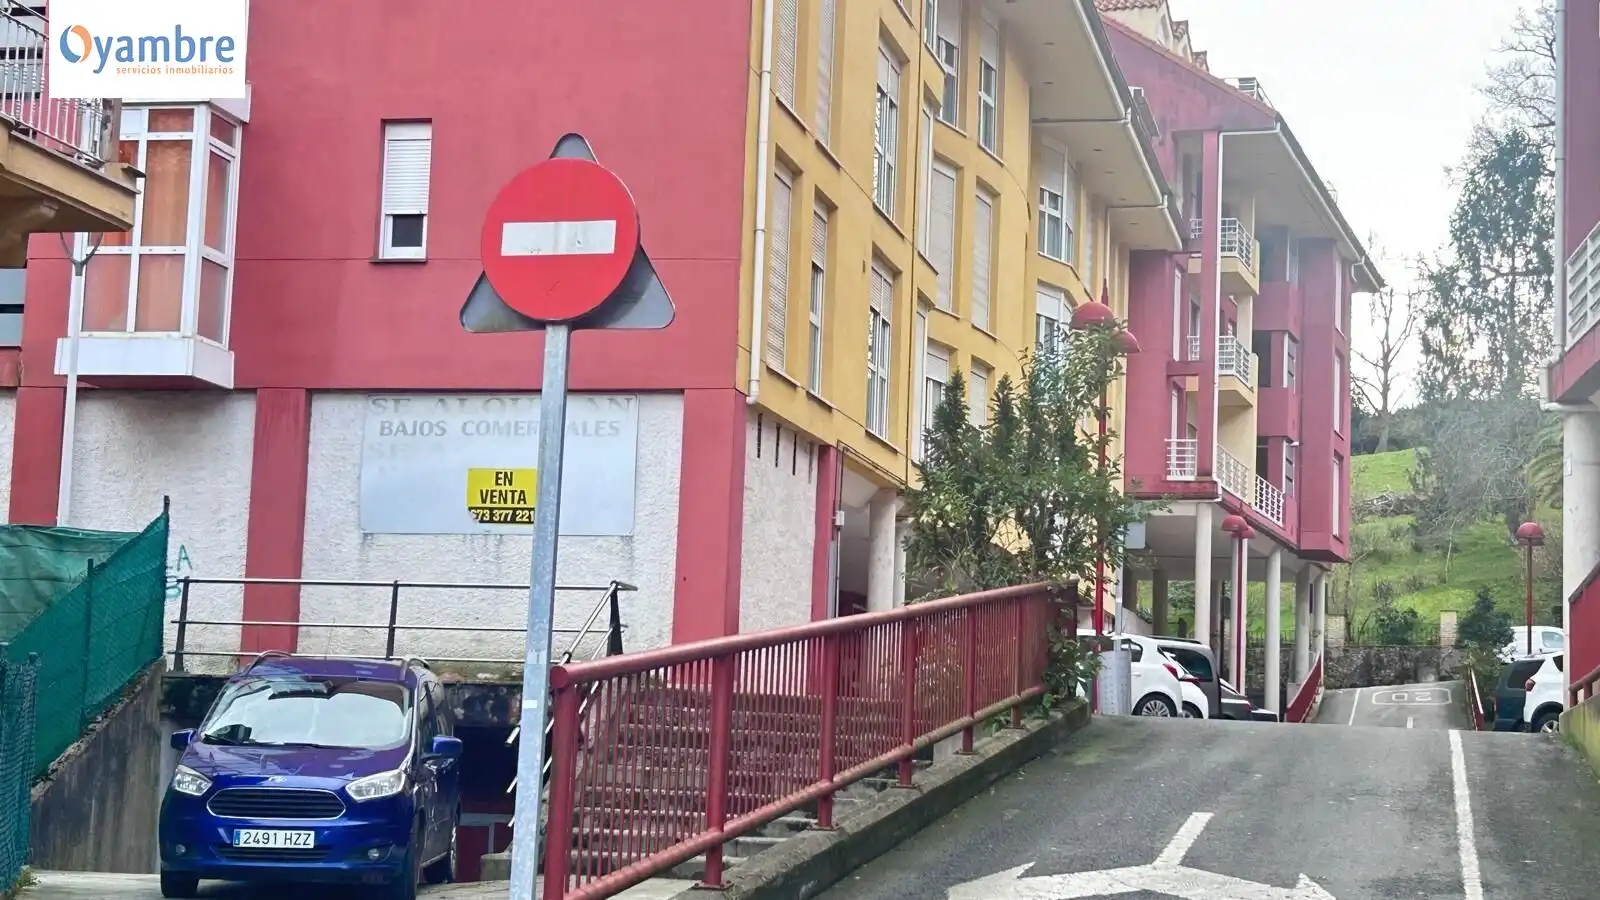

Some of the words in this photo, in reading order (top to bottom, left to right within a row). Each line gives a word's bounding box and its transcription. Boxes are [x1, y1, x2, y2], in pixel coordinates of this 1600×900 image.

[380, 420, 447, 437] BAJOS
[461, 420, 621, 437] COMERALES
[495, 471, 513, 486] EN
[480, 489, 527, 504] VENTA
[492, 510, 513, 522] 377
[515, 510, 534, 522] 221
[243, 832, 277, 846] 2491
[284, 832, 311, 846] HZZ
